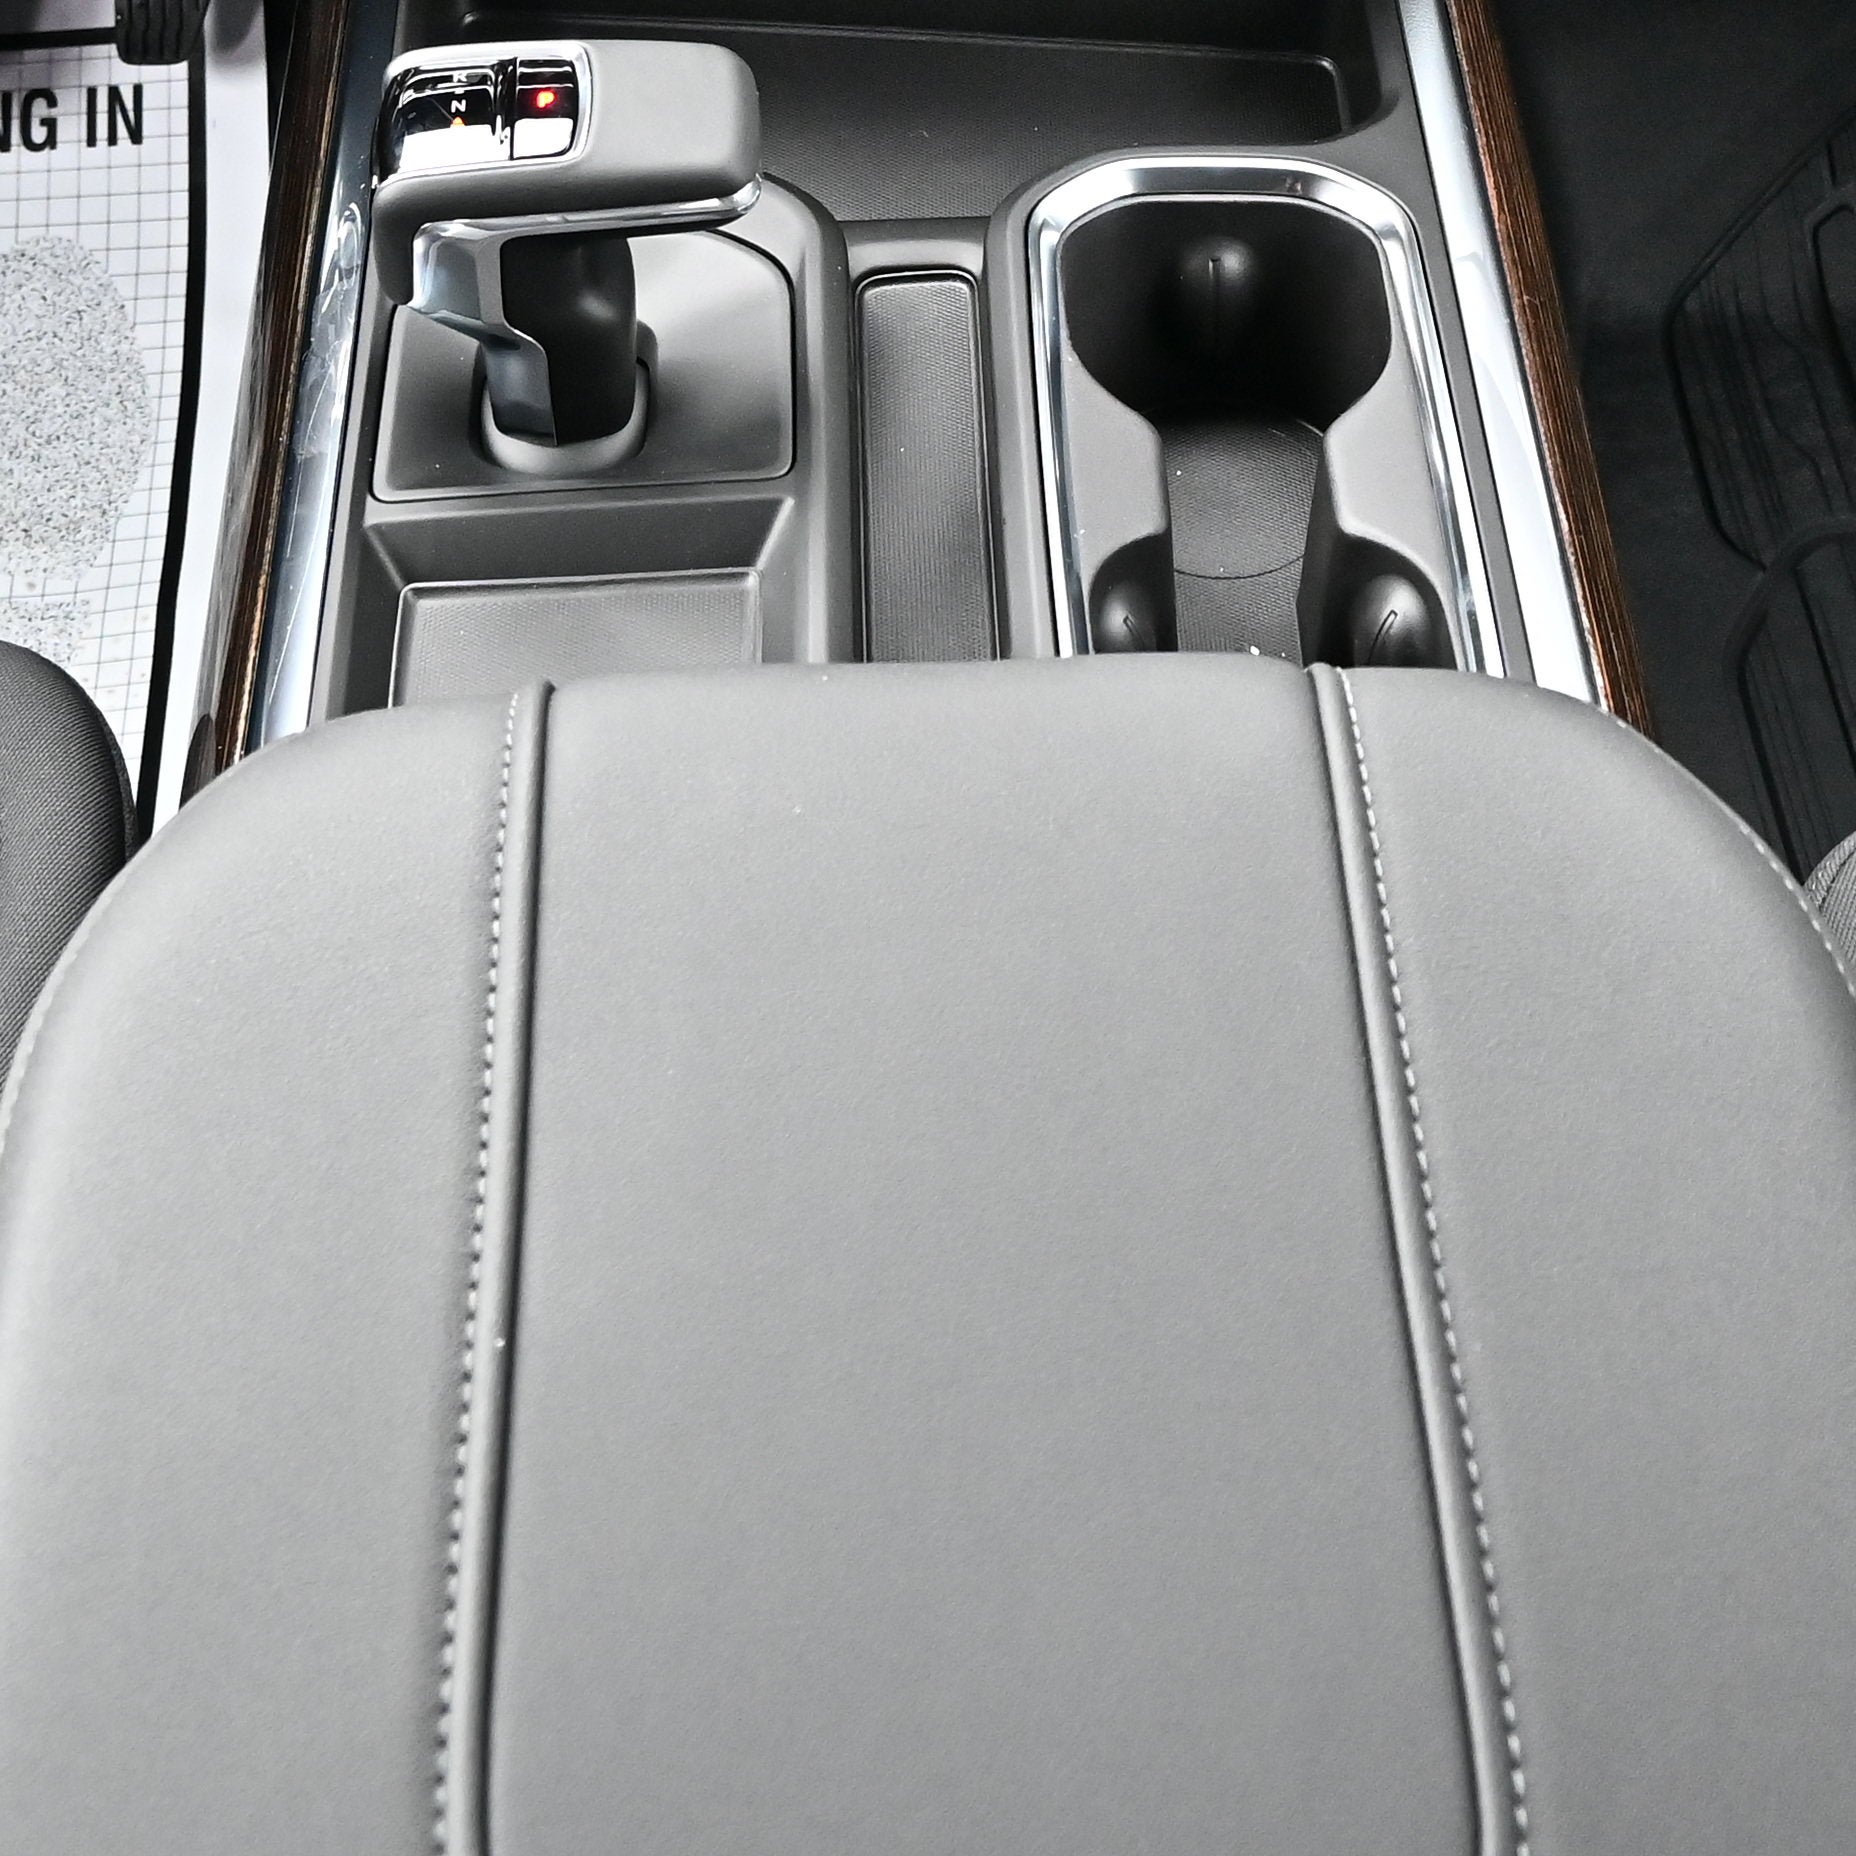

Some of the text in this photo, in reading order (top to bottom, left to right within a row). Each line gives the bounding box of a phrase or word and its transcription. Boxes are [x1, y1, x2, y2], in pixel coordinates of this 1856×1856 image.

[450, 99, 467, 113] N
[535, 88, 556, 109] P
[85, 81, 145, 148] IN
